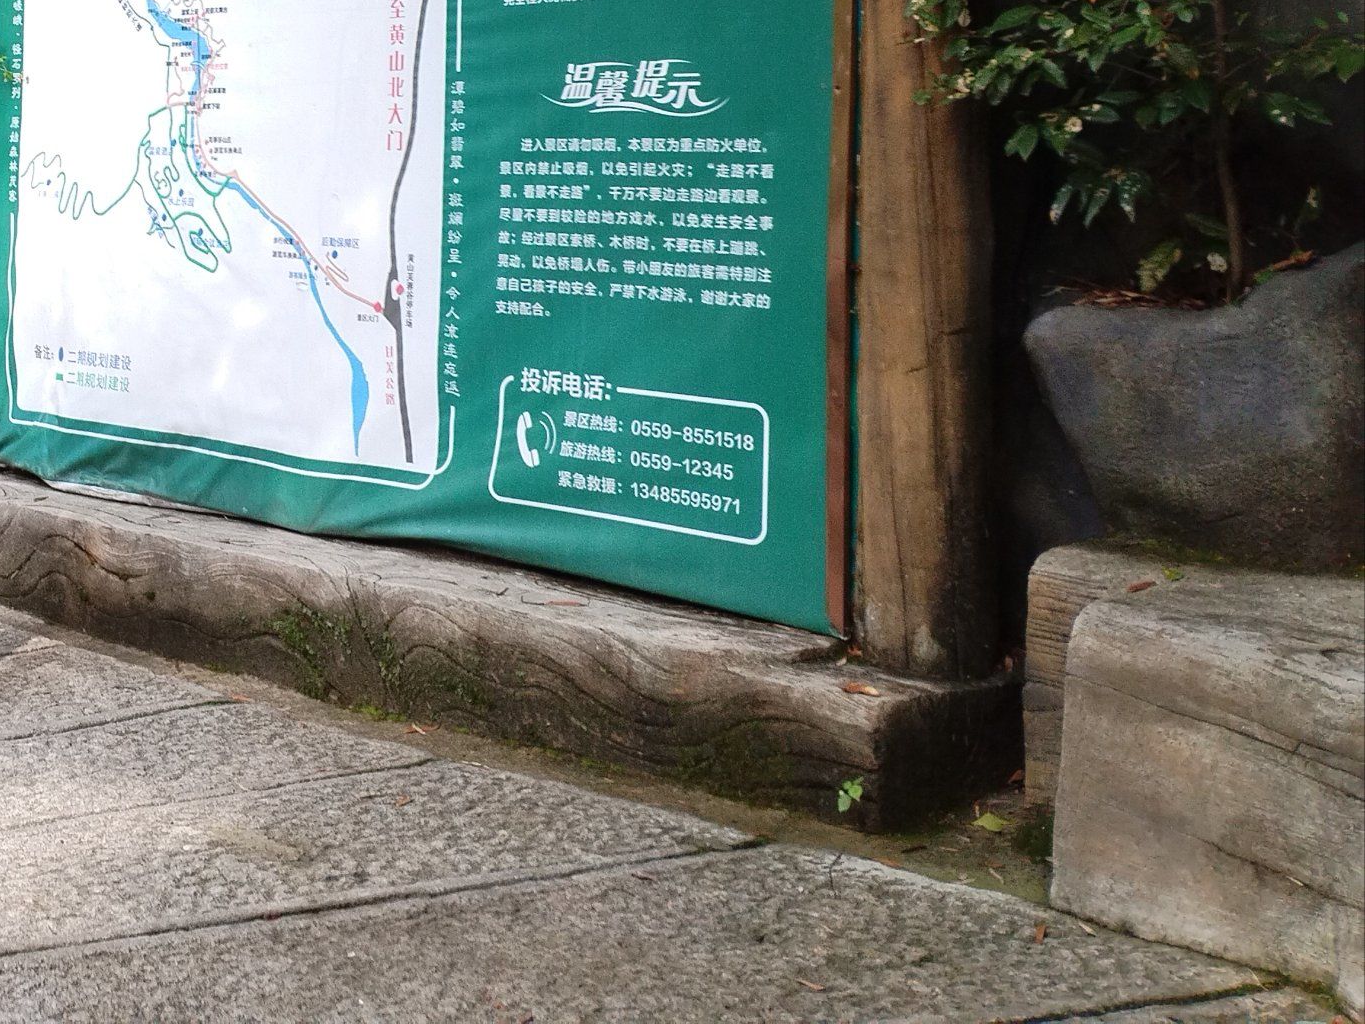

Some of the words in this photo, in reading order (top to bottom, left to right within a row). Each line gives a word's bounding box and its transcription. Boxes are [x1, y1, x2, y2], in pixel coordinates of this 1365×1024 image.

[560, 58, 702, 109] 温馨提示
[494, 300, 552, 317] 支持配合。
[520, 366, 613, 401] 投诉电话：
